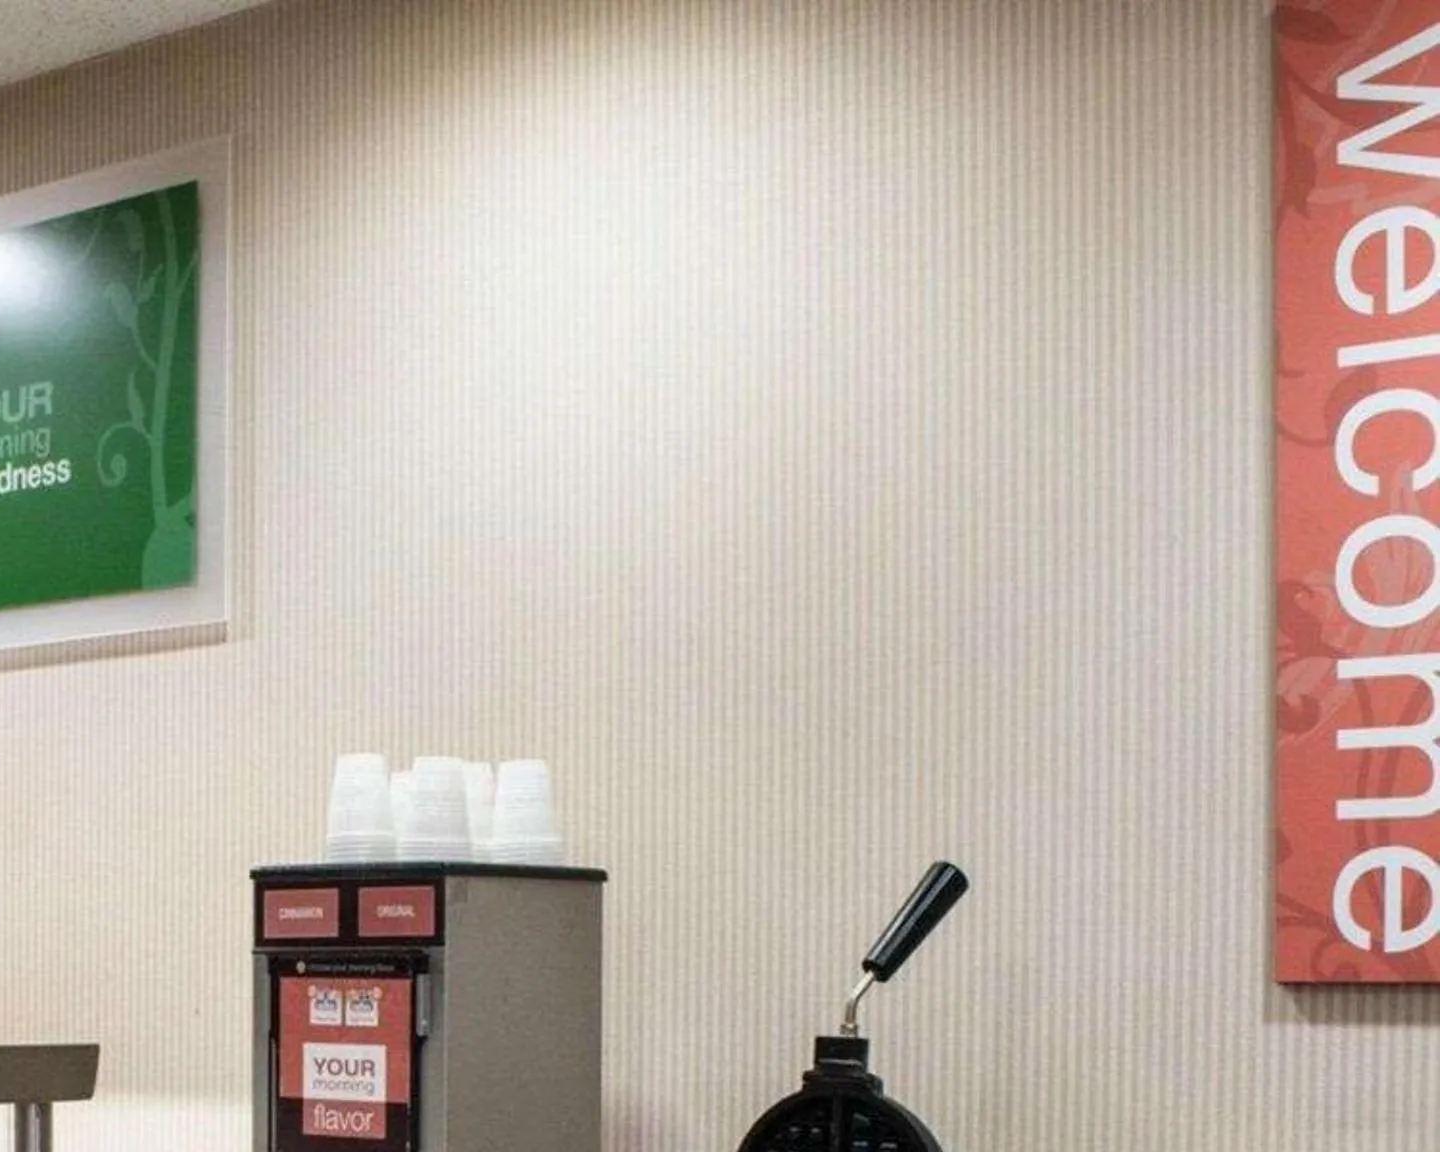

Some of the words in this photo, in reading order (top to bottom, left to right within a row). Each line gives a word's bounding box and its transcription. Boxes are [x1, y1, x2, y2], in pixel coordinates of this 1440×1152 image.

[1333, 21, 1440, 953] welcome
[313, 1057, 376, 1077] YOUR
[312, 1079, 376, 1097] morning
[313, 1103, 374, 1132] flavor
